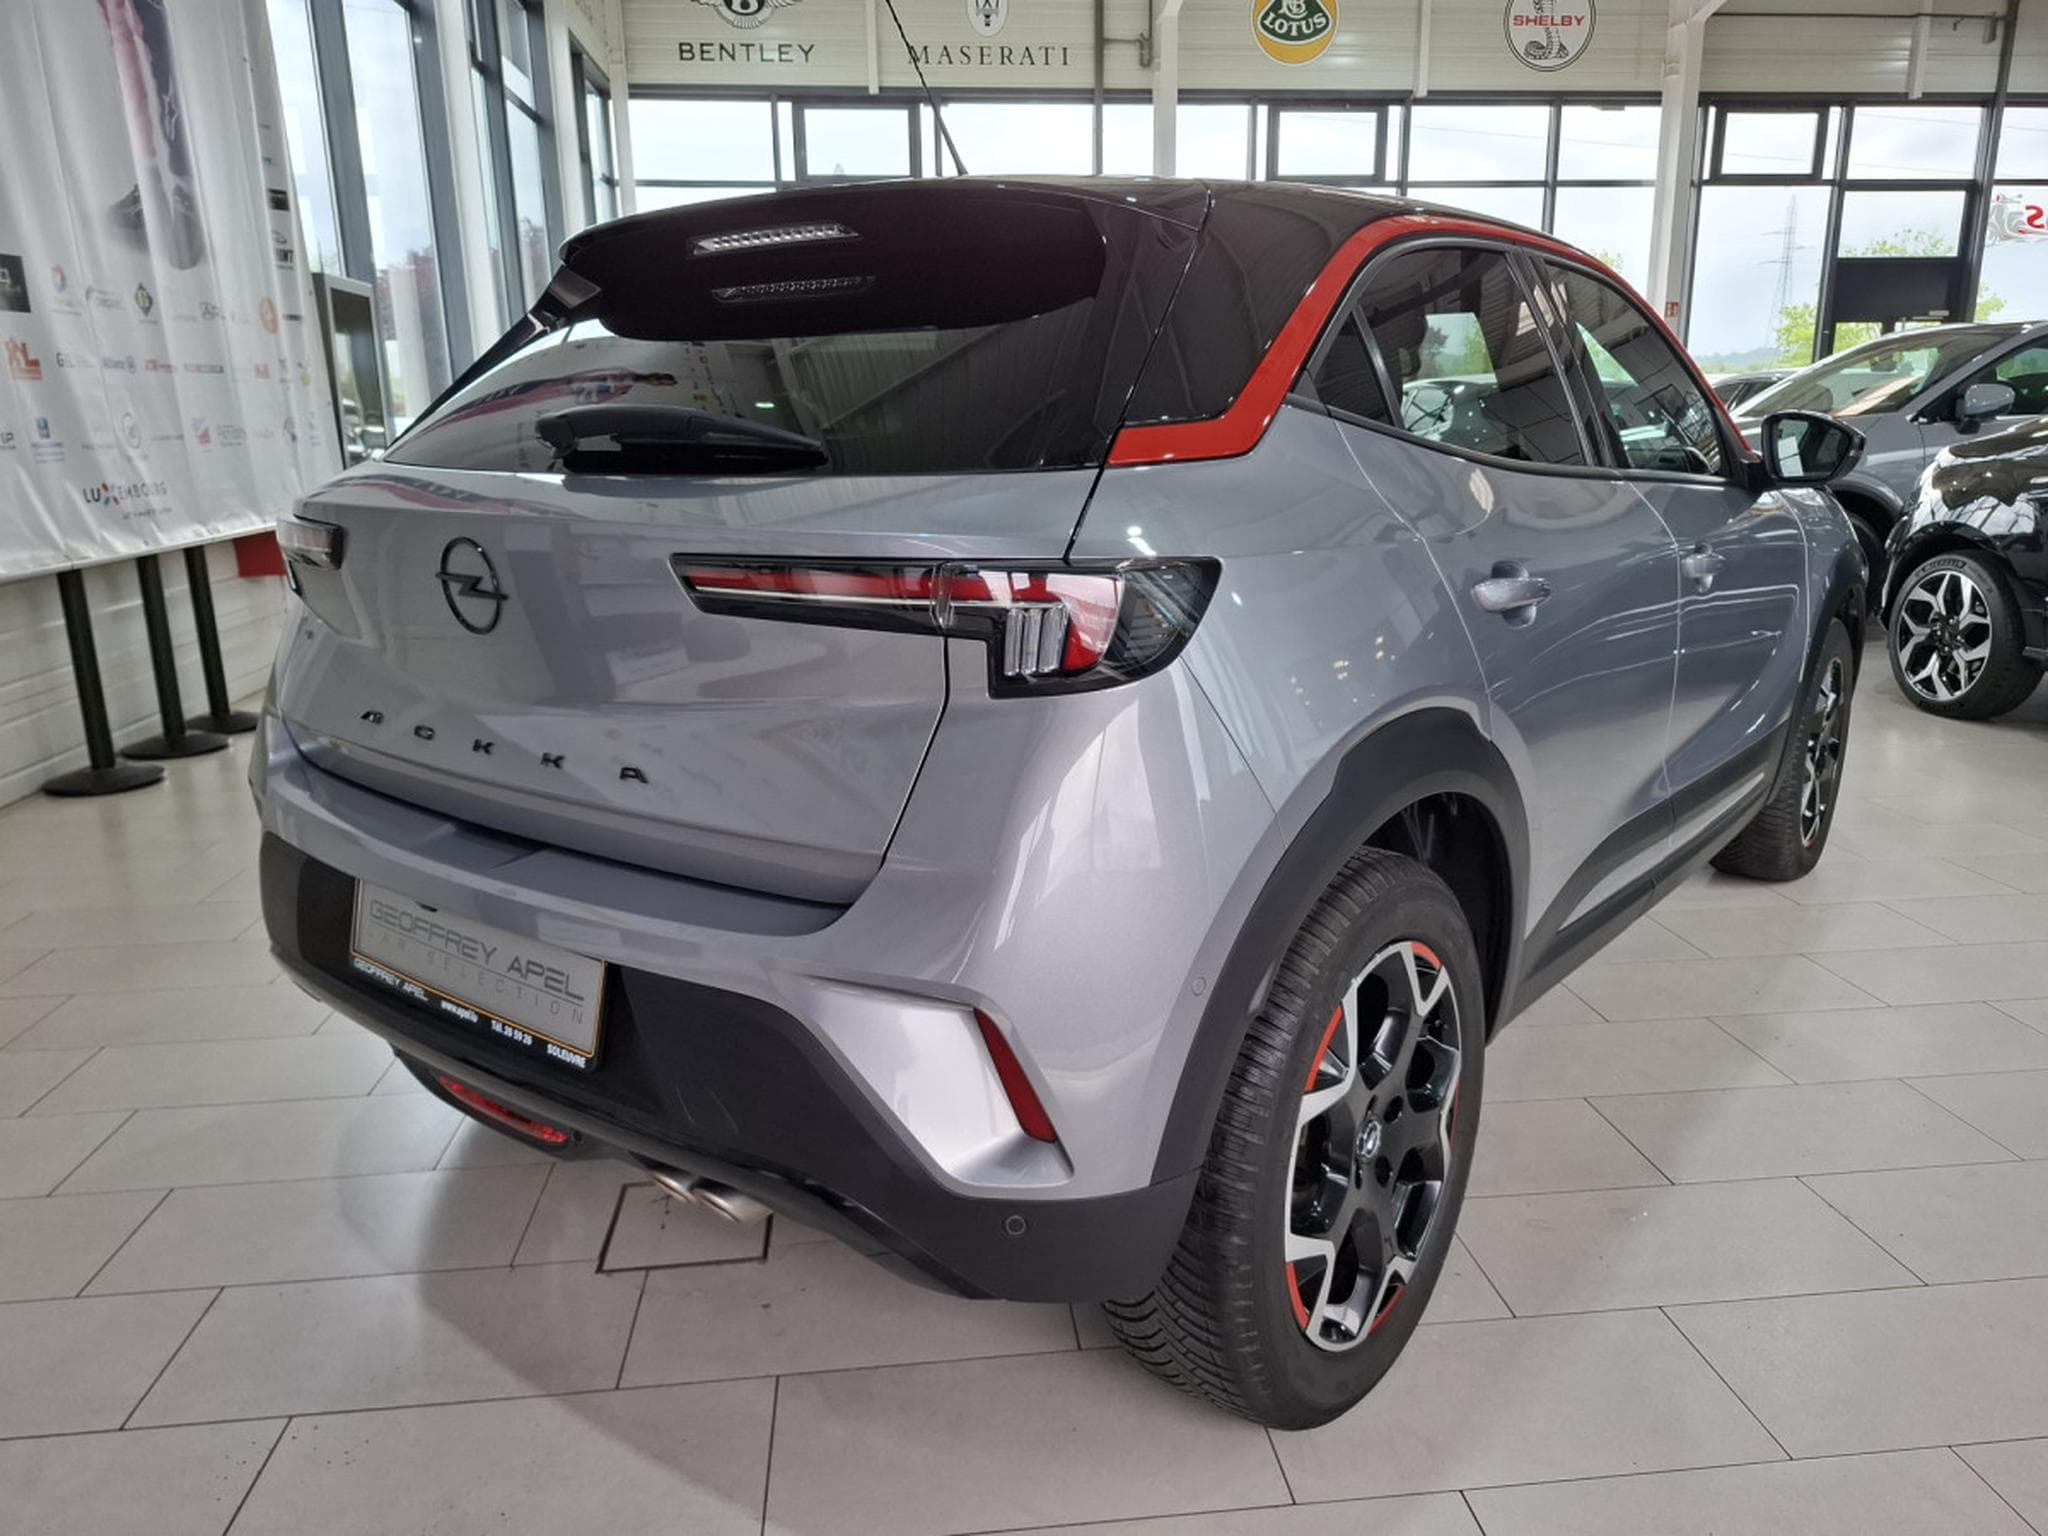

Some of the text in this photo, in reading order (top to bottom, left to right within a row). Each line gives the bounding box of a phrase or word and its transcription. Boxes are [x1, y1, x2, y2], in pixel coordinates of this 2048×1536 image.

[1263, 12, 1327, 36] LOTUS
[1513, 15, 1584, 26] SHELBY
[678, 42, 815, 62] BENTLEY
[908, 45, 1069, 66] MASERATI
[370, 899, 584, 1002] GEOFFREY APEL
